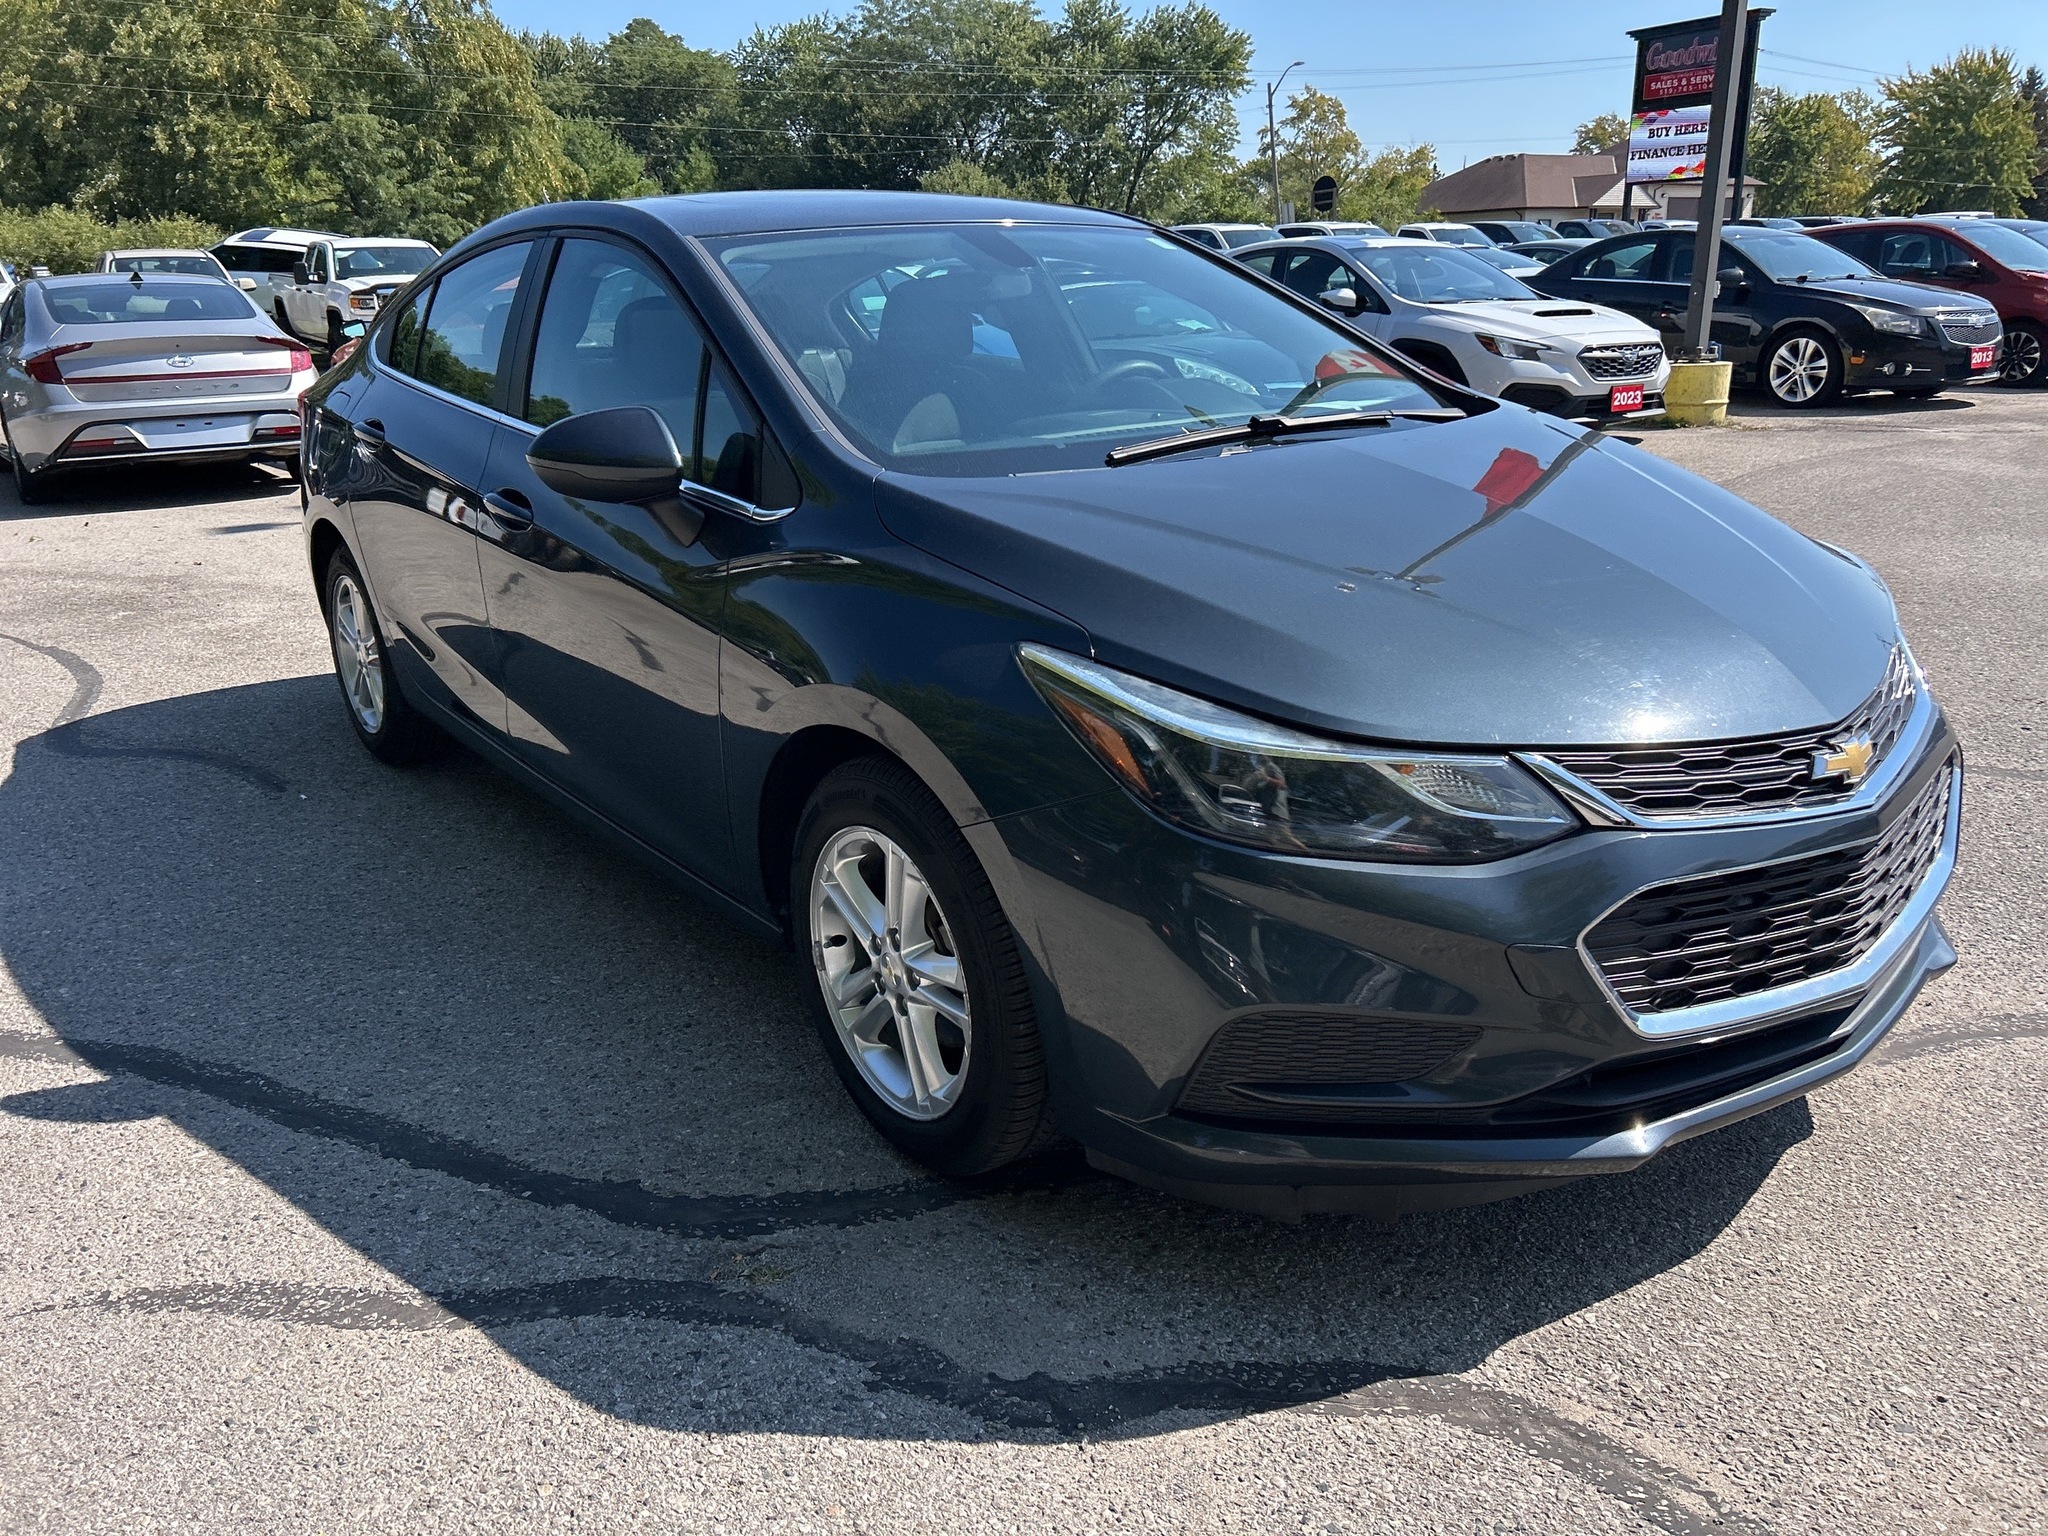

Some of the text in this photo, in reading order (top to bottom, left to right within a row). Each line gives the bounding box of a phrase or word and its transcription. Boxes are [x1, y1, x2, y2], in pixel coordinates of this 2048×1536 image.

[1650, 79, 1678, 90] SALES
[1681, 77, 1687, 86] &
[1647, 122, 1708, 139] BUY HERE
[1630, 145, 1685, 161] FINANCE
[1971, 351, 1993, 364] 2013
[1613, 391, 1642, 406] 2023
